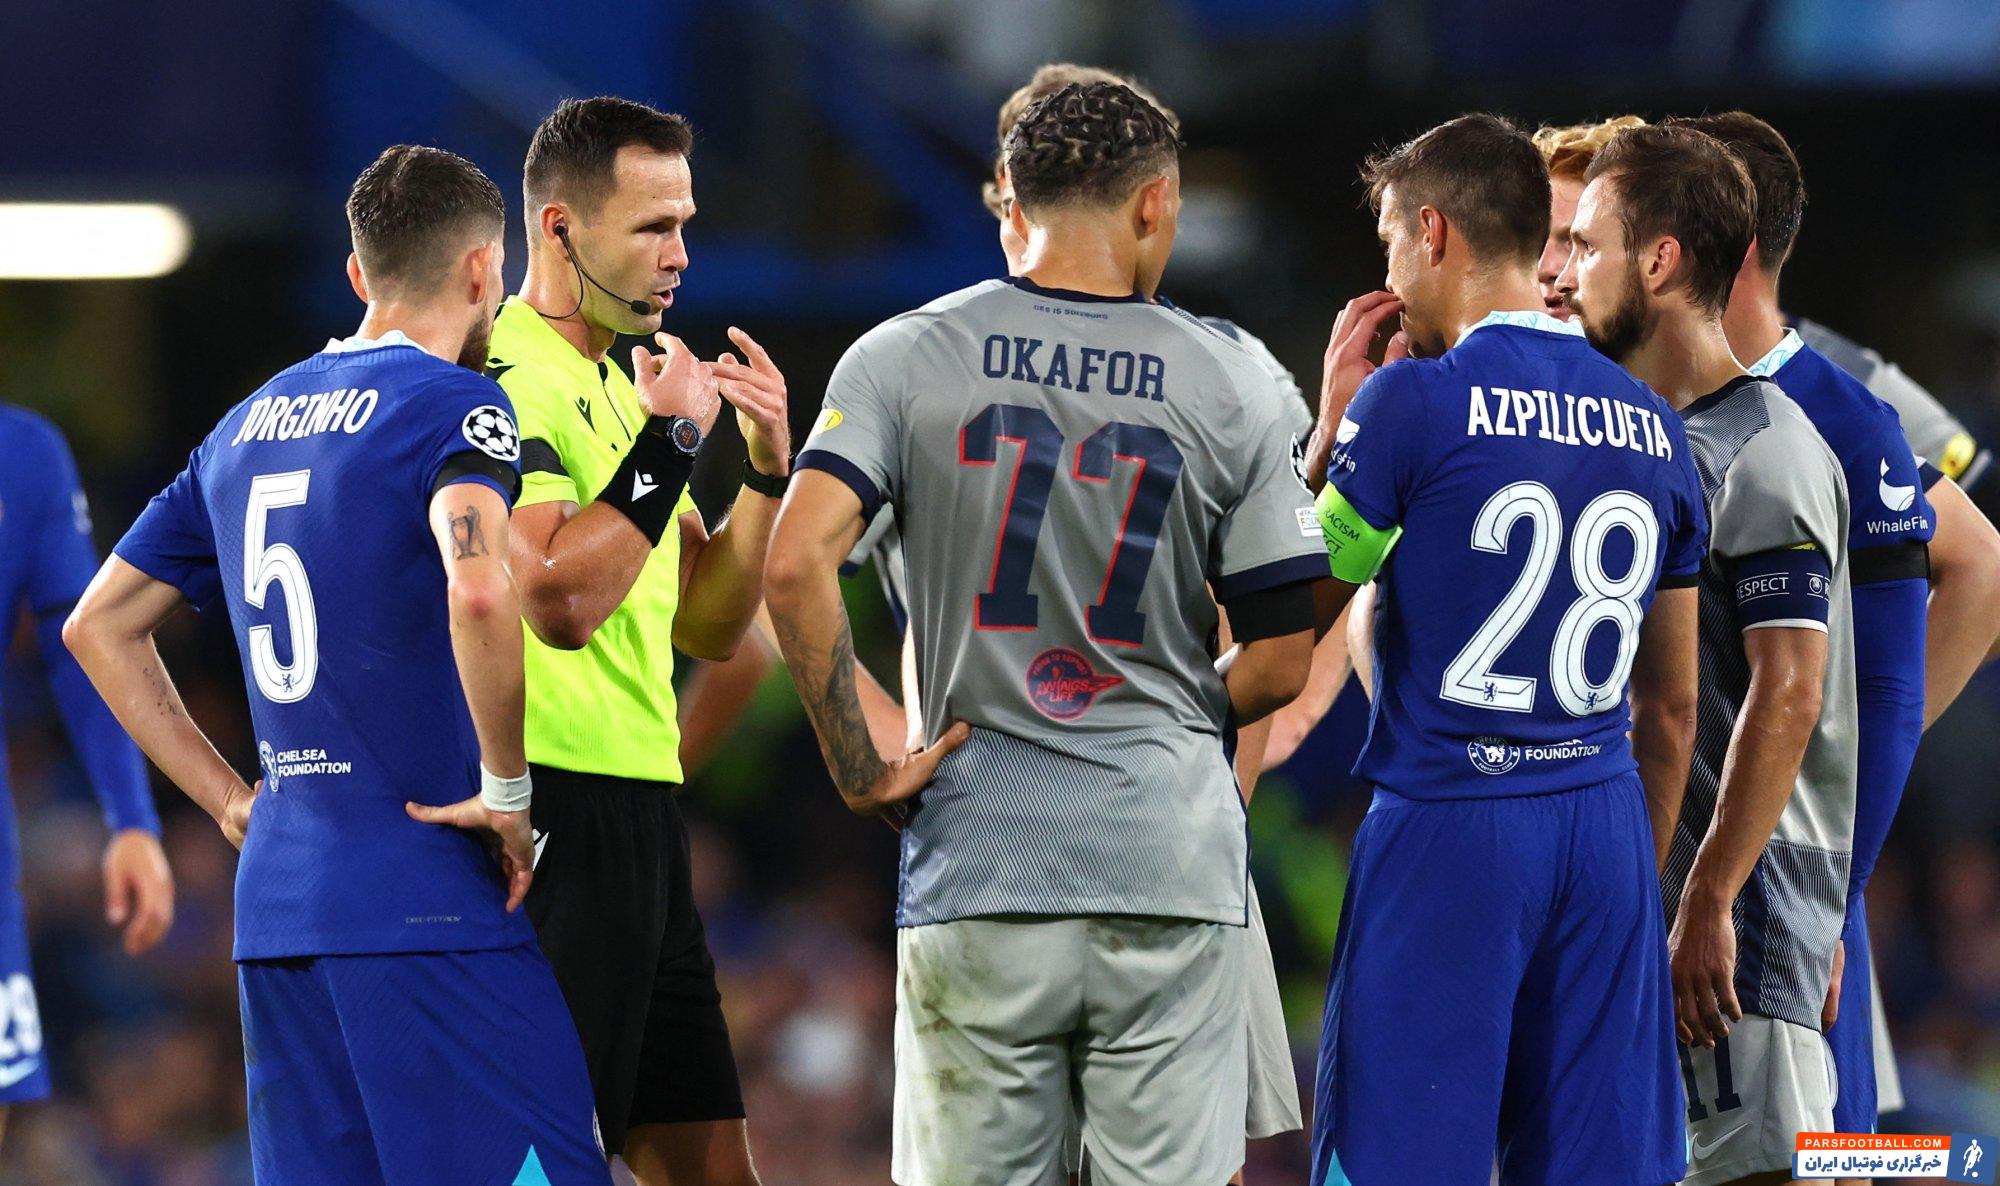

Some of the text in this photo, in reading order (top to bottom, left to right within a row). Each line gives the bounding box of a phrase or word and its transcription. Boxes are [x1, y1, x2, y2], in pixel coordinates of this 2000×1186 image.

[982, 334, 1165, 402] OKAFOR
[231, 388, 379, 448] JORGINHO
[1467, 385, 1673, 463] AZPILICUETA
[959, 403, 1184, 650] 77
[1866, 515, 1929, 534] WhaleFin
[243, 468, 319, 704] 5
[1438, 480, 1660, 719] 28
[277, 749, 327, 763] CHELSEA
[278, 761, 352, 778] FOUNDATION
[1525, 744, 1602, 761] FOUNDATION
